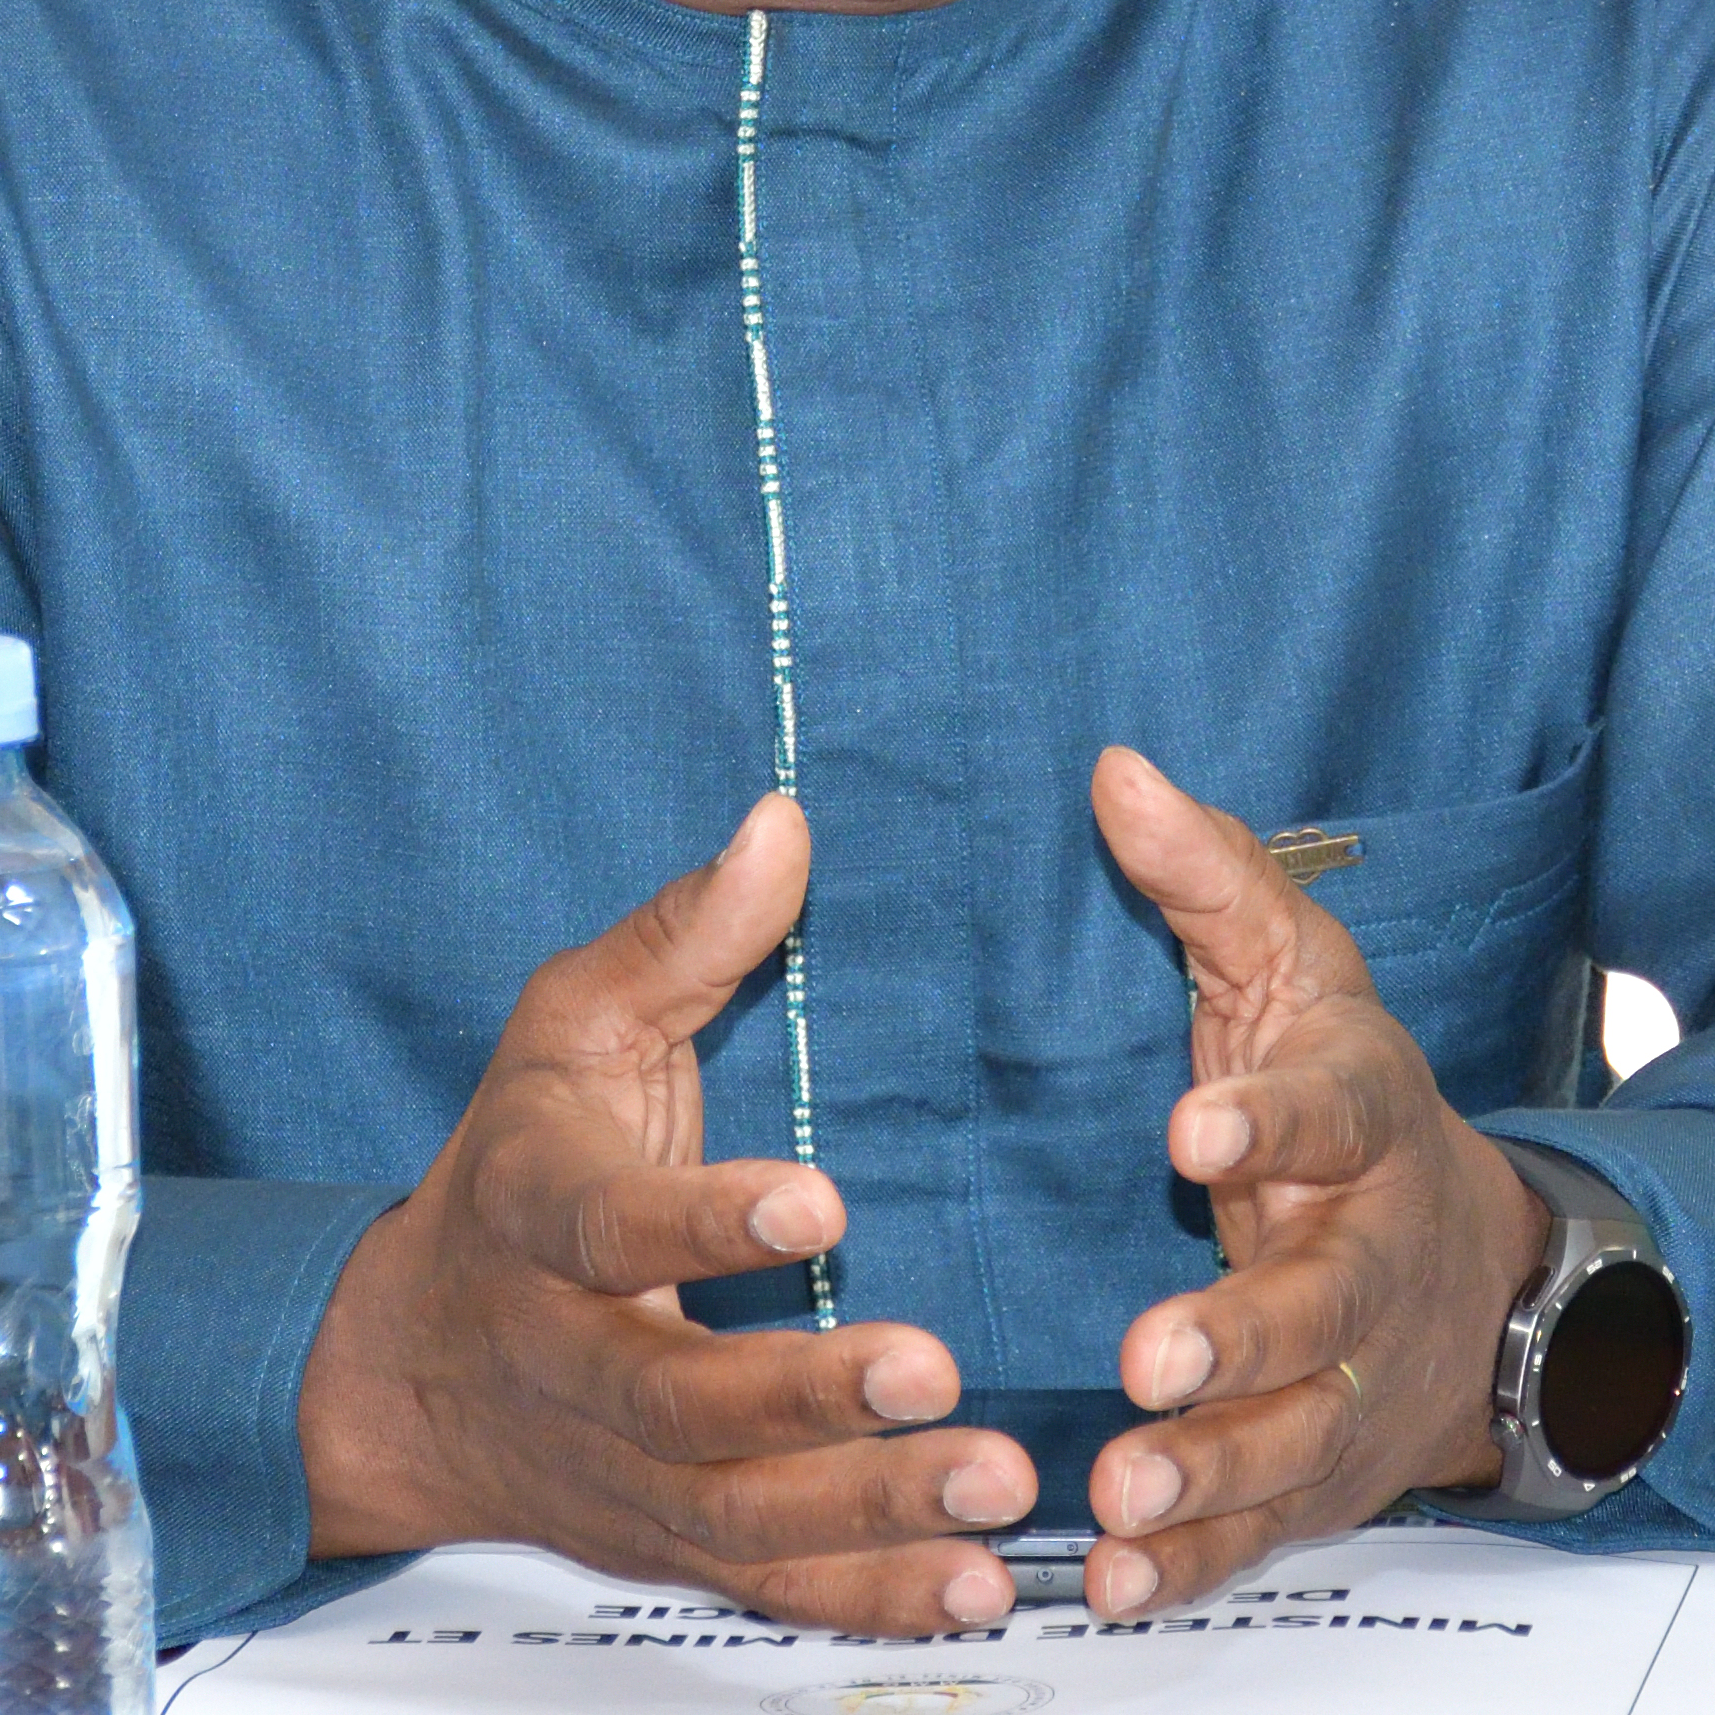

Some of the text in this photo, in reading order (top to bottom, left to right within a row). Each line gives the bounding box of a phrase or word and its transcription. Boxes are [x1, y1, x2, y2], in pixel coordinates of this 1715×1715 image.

[1227, 1588, 1350, 1604] DE
[1036, 1614, 1533, 1640] MINISTERE
[367, 1629, 482, 1644] ET
[510, 1631, 799, 1647] MINES
